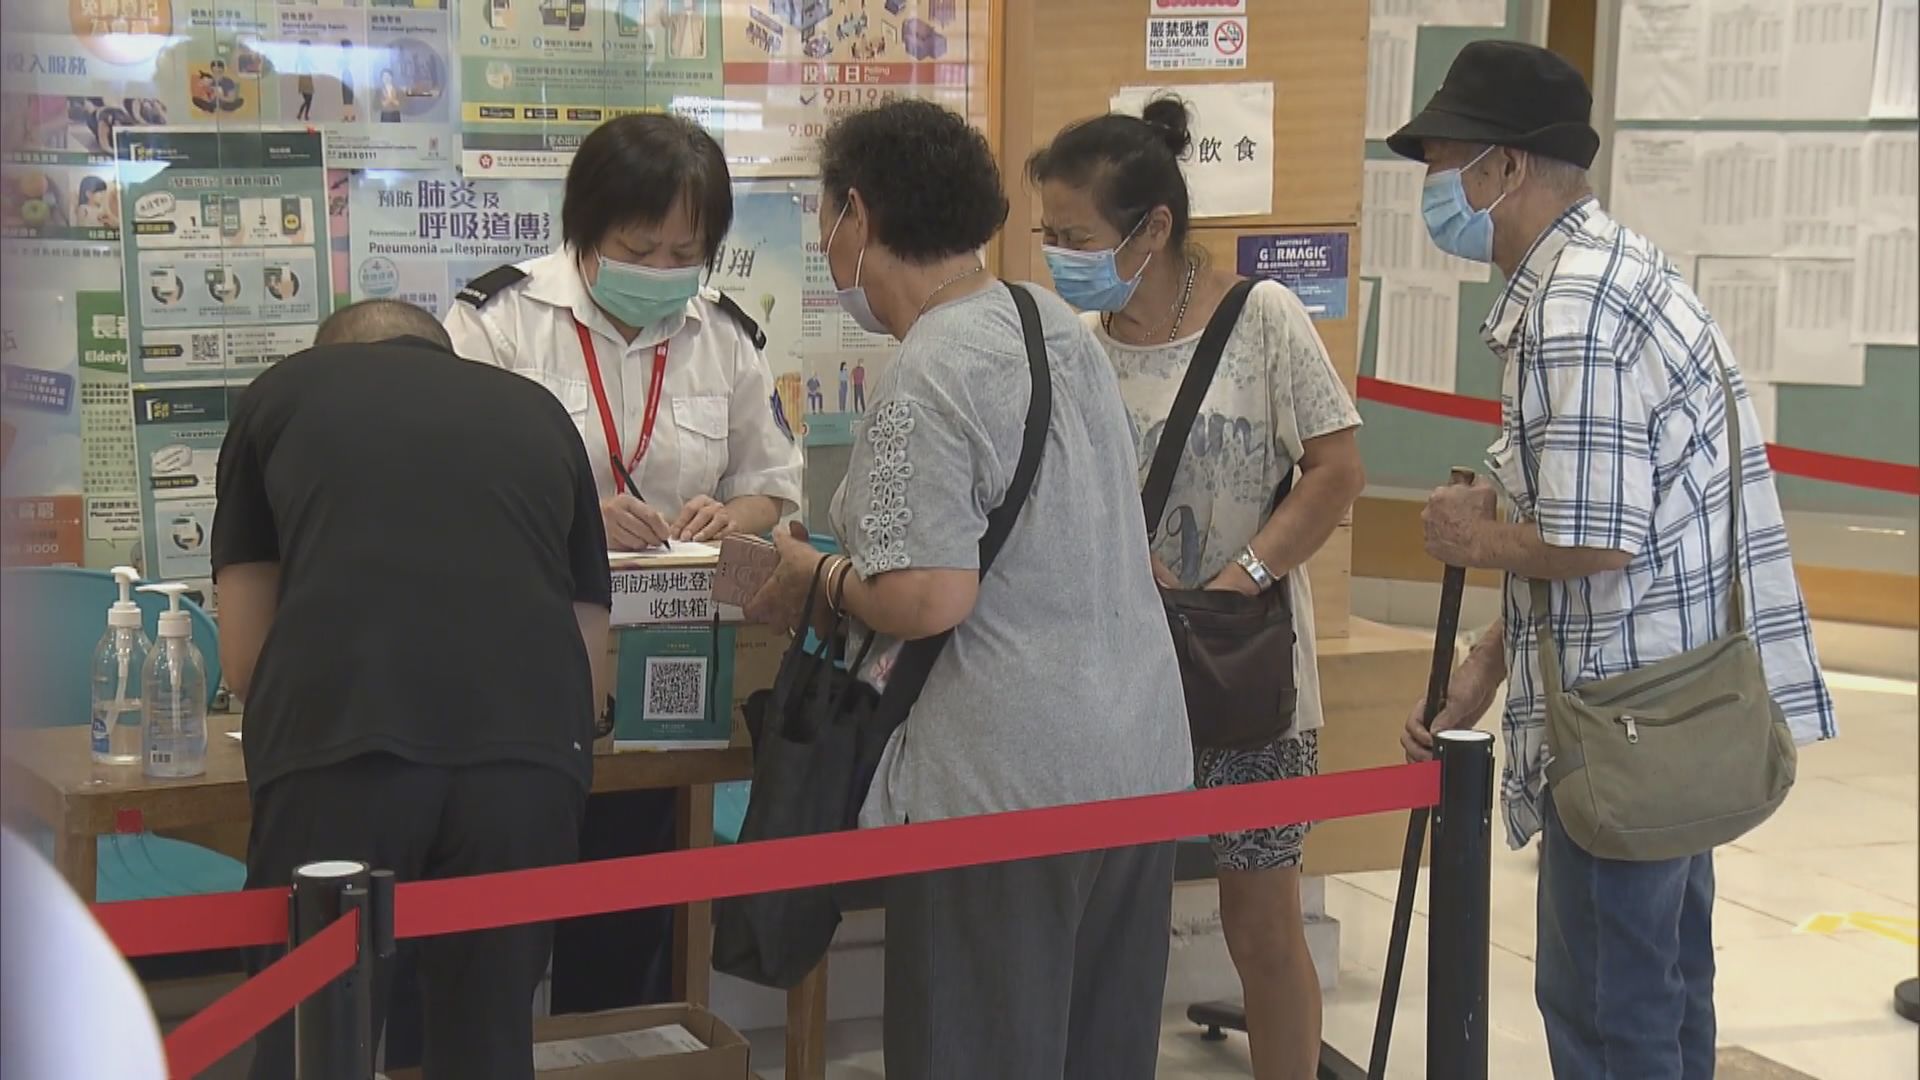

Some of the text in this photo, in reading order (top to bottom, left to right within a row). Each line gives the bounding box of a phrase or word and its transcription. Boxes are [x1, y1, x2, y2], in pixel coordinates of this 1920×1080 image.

[1150, 20, 1209, 38] 嚴禁吸煙
[1150, 38, 1209, 48] NO SMOKING
[803, 64, 861, 83] 投票日
[864, 66, 890, 76] Polling
[864, 75, 880, 84] Day
[788, 123, 824, 138] 9:00
[359, 151, 377, 160] 0111
[419, 212, 550, 241] 呼吸道傳
[369, 243, 438, 254] Pneumonia
[454, 243, 521, 257] Respiratory
[524, 244, 550, 256] Tract
[84, 350, 128, 366] Elderly
[610, 571, 713, 594] 到訪場地登
[649, 597, 708, 619] 收集箱
